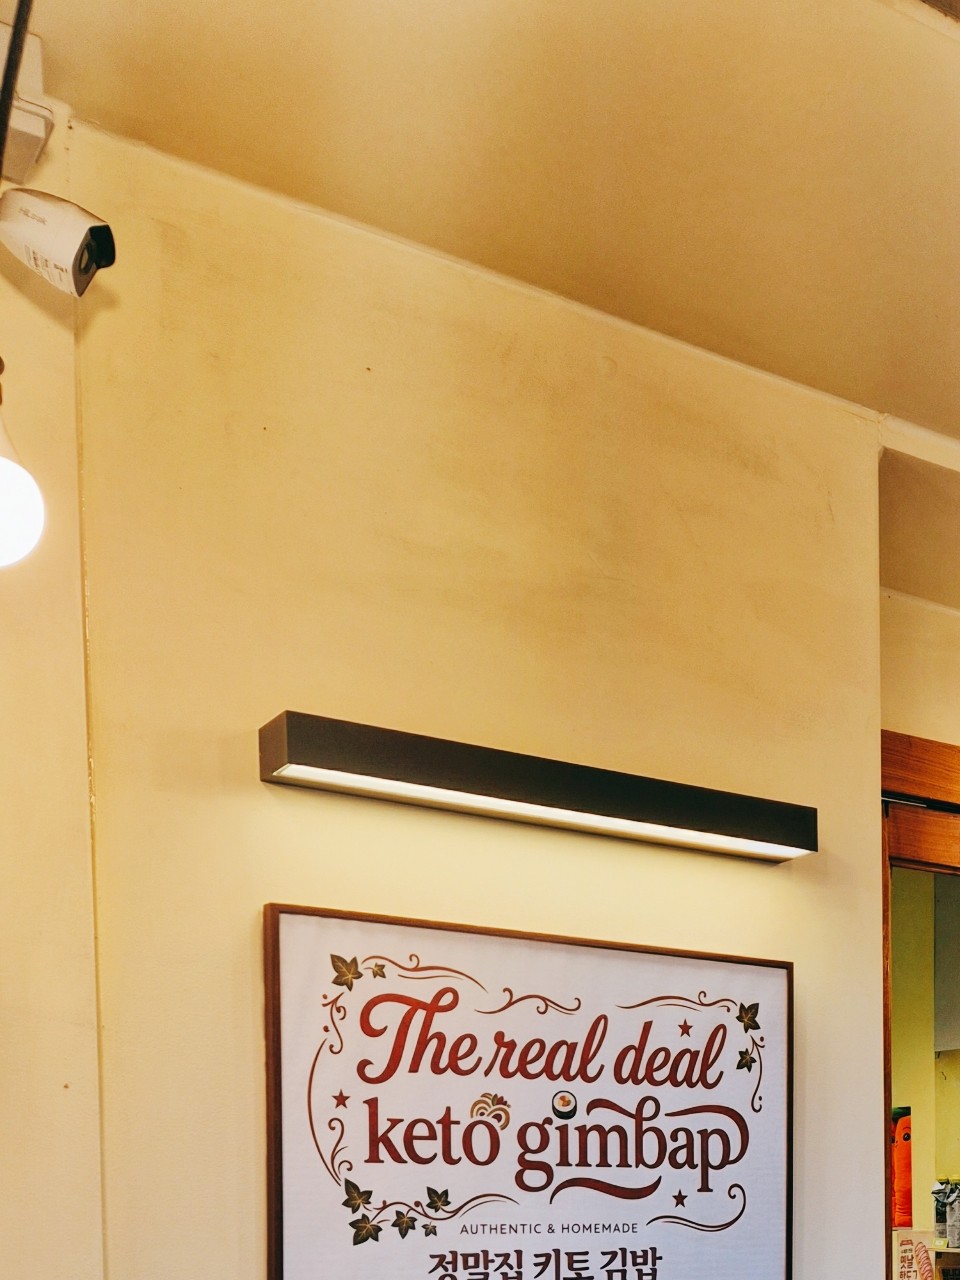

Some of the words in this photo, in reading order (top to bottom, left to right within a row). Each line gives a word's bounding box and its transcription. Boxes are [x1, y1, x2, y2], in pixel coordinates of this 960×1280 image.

[356, 987, 483, 1085] The
[484, 1014, 609, 1085] real
[613, 1019, 728, 1090] deal
[362, 1096, 502, 1167] keto
[514, 1096, 750, 1200] gimbap
[459, 1223, 542, 1235] AUTHENTIC
[547, 1224, 556, 1235] &
[560, 1222, 639, 1235] HOMEMADE
